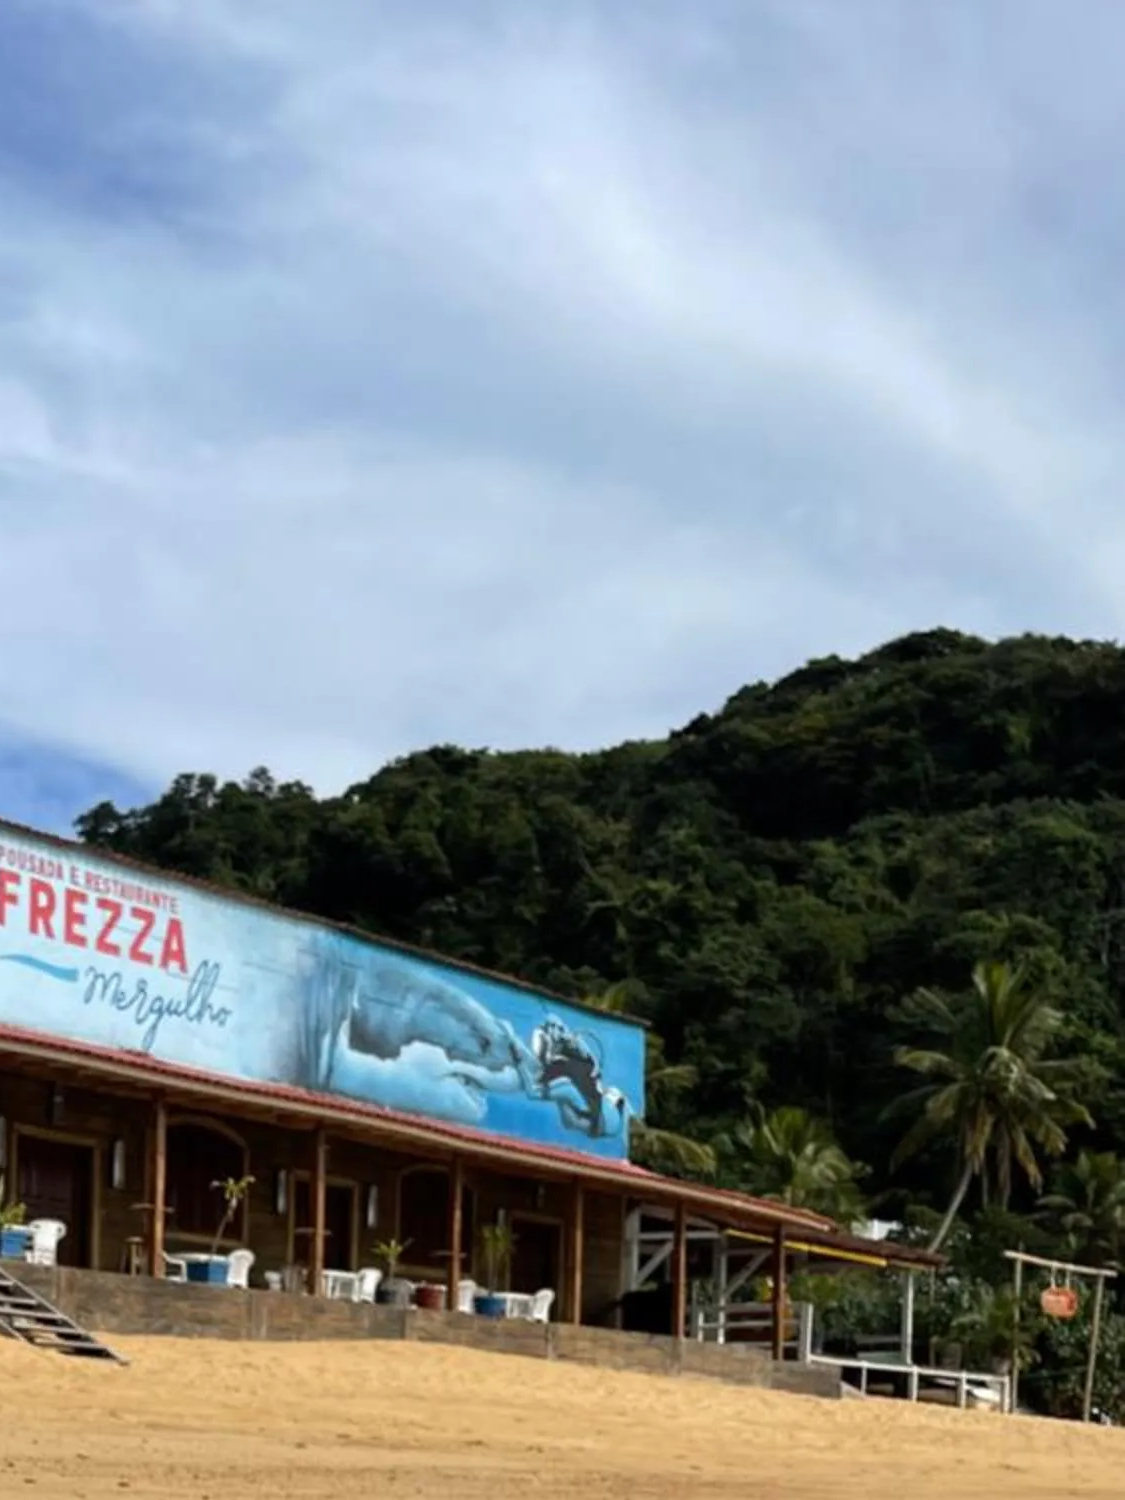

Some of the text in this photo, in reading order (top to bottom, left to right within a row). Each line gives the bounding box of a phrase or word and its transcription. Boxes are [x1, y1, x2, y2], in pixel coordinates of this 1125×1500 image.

[70, 864, 80, 886] E
[85, 871, 179, 914] RESTAURANTE
[83, 959, 233, 1052] Mergulho
